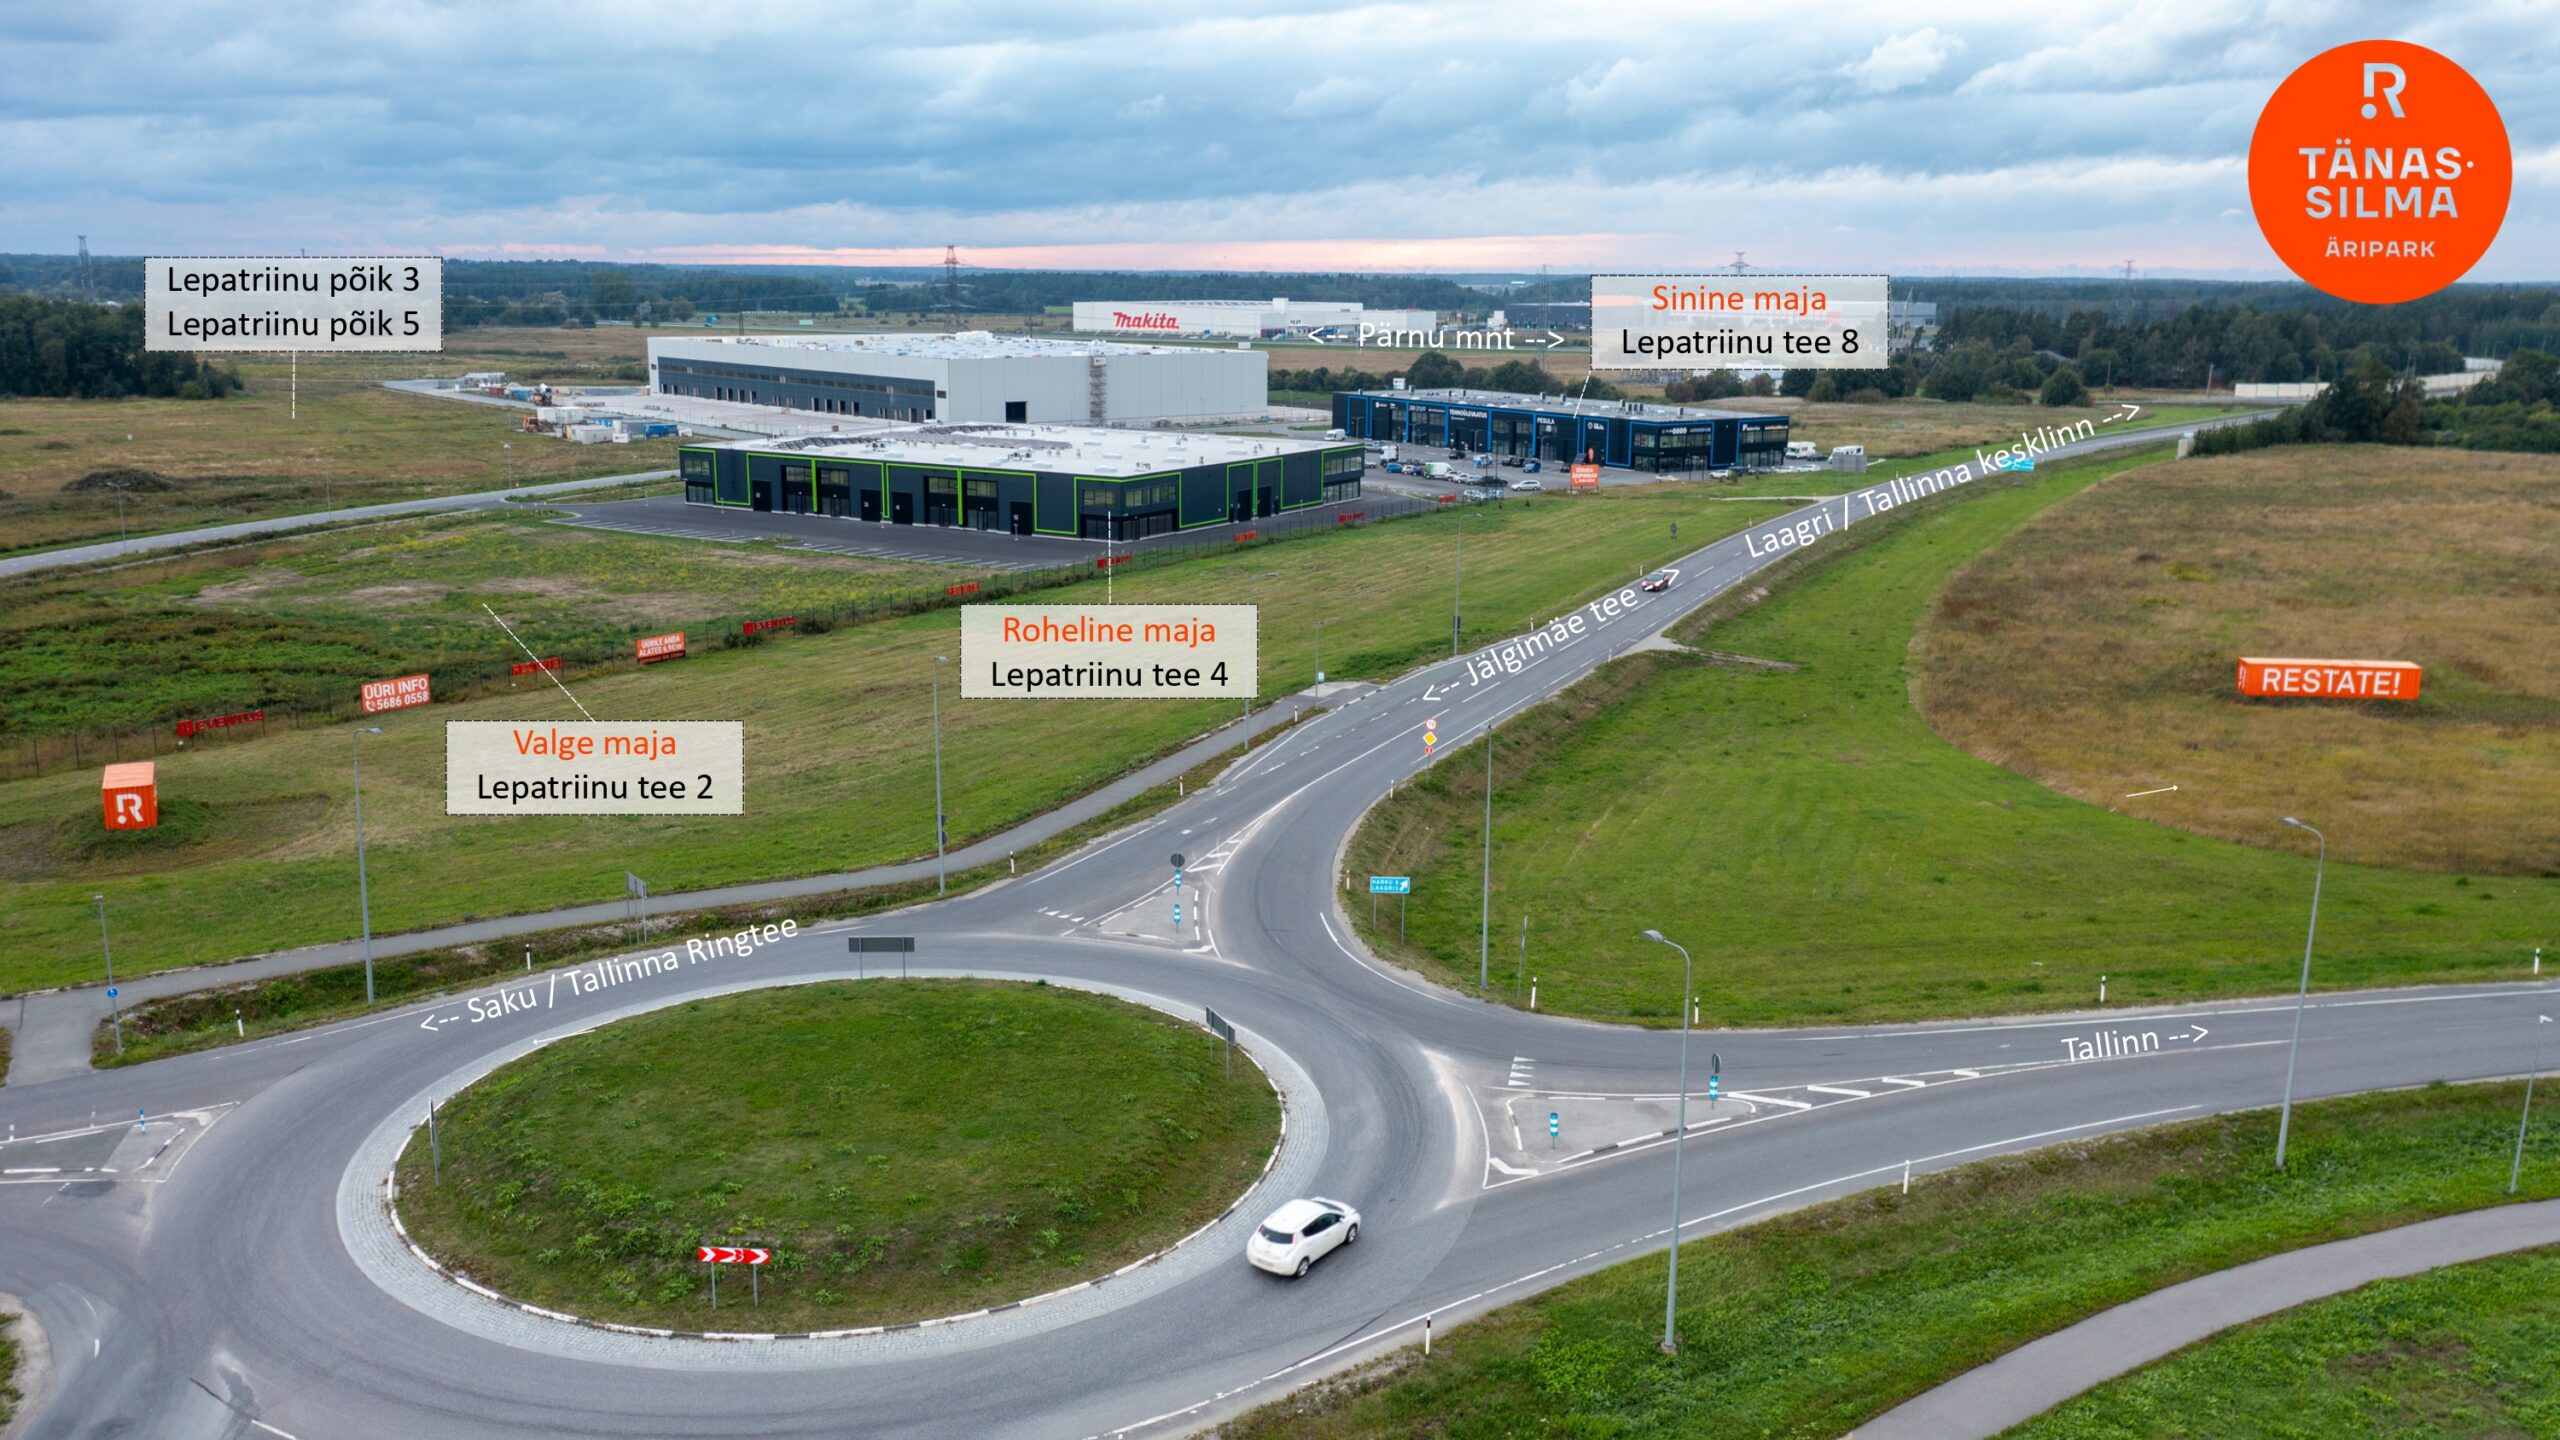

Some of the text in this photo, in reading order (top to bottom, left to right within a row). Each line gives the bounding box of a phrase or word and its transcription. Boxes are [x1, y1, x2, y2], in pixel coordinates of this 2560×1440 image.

[364, 678, 428, 700] ÜÜRI INFO
[2262, 667, 2401, 696] RESTATE!
[377, 691, 429, 711] 5686 0558
